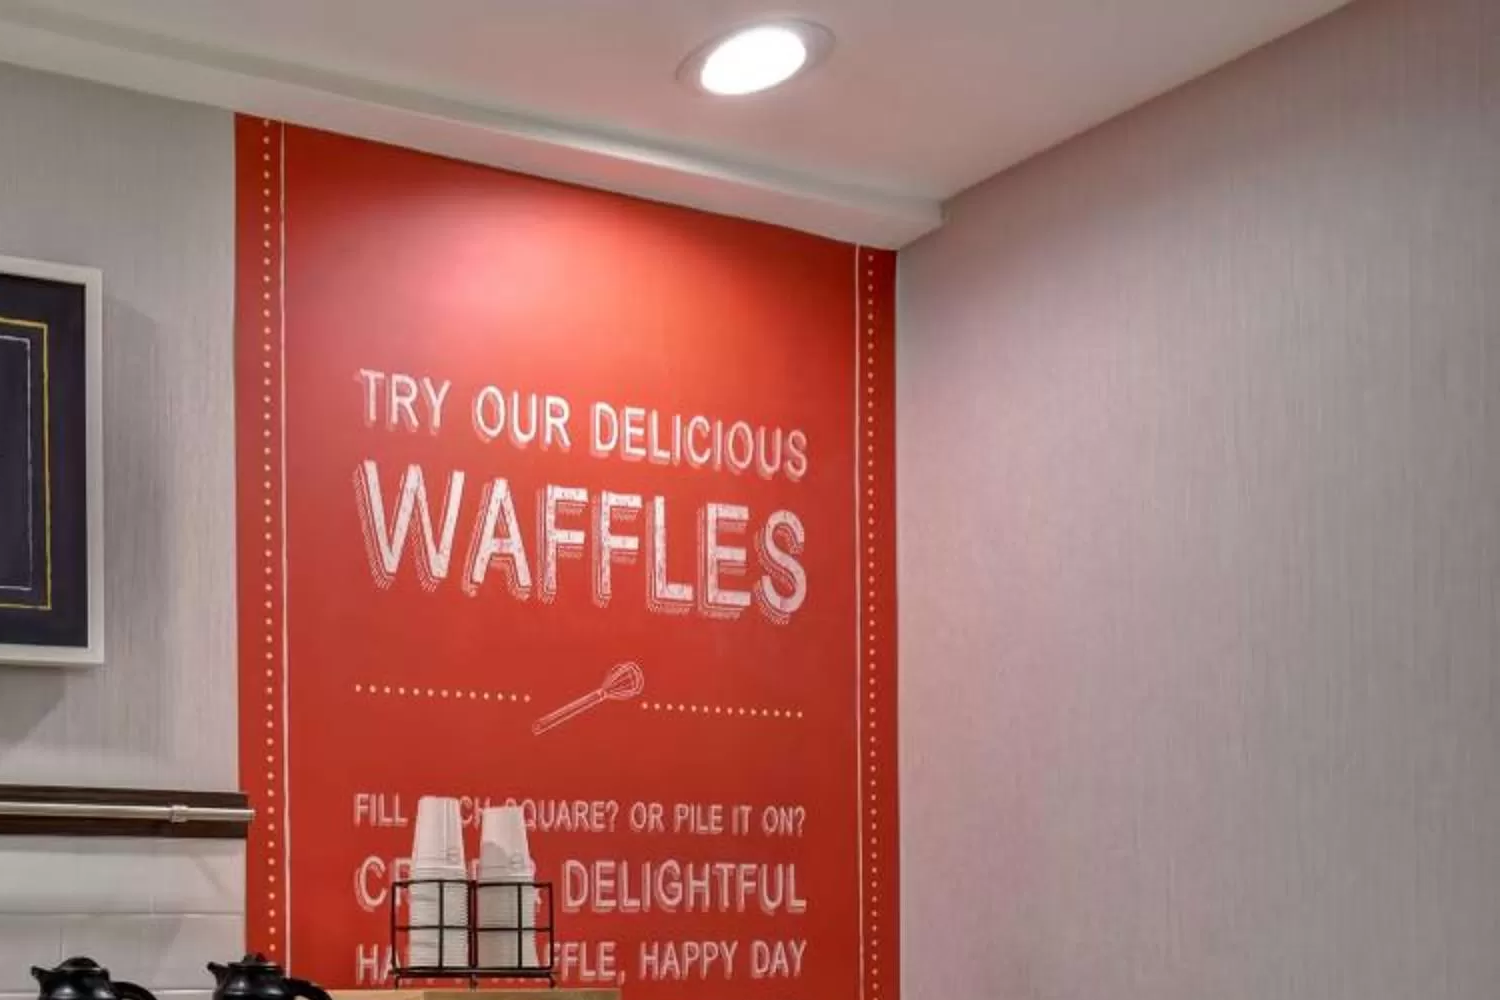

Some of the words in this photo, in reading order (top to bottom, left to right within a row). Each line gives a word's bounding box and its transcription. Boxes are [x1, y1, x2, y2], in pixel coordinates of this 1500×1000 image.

[356, 368, 451, 433] TRY
[473, 385, 572, 451] OUR
[590, 402, 809, 481] DELICIOUS
[353, 459, 809, 625] WAFFLES
[353, 793, 408, 827] FILL
[630, 801, 665, 833] OR
[673, 803, 724, 835] PILE
[731, 805, 753, 837] IT
[761, 805, 806, 838] ON?
[561, 859, 808, 915] DELIGHTFUL
[542, 940, 626, 985] FFLE,
[639, 939, 739, 981] HAPPY
[750, 939, 808, 980] DAY
